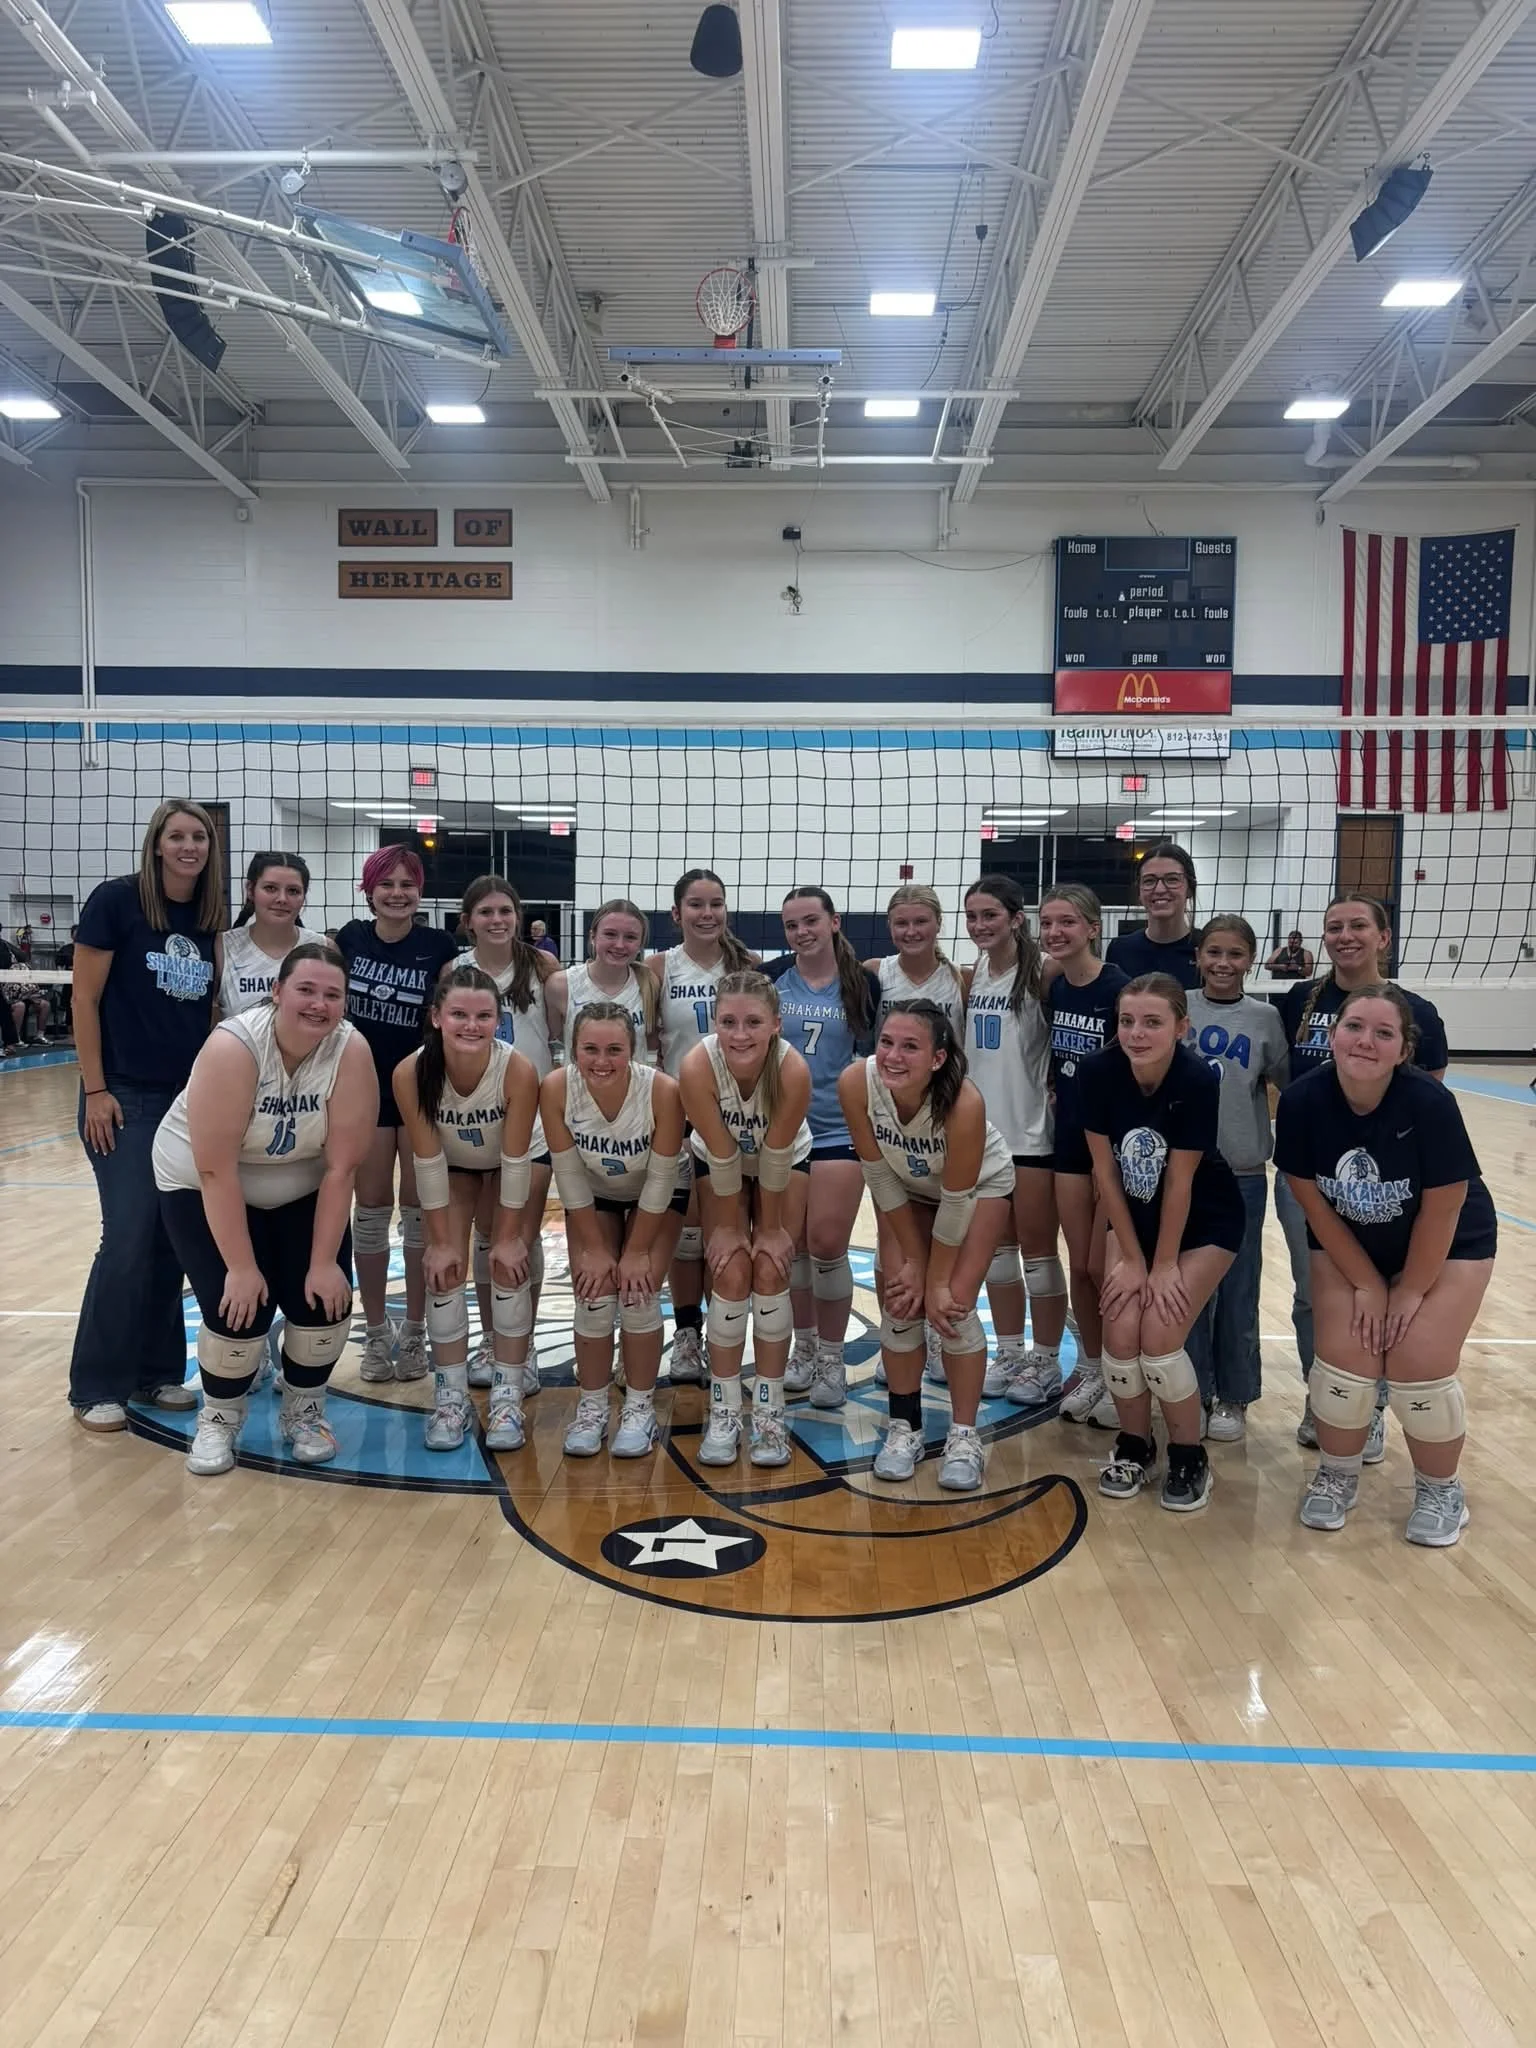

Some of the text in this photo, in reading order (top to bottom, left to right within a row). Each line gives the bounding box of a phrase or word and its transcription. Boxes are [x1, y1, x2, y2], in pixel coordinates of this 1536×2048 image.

[348, 519, 502, 536] WALL OF
[1068, 541, 1096, 554] Home
[1195, 542, 1232, 554] Guests
[349, 572, 502, 588] HERITAGE
[1130, 585, 1164, 599] period
[1064, 606, 1088, 619] fouls
[1128, 606, 1162, 620] player
[1204, 607, 1229, 619] fouls
[1065, 653, 1085, 663] won
[1132, 653, 1158, 665] game
[1205, 654, 1226, 663] won
[350, 956, 428, 991] SHAKAMAK
[240, 977, 274, 992] SHAK
[670, 985, 716, 999] SHAKA
[347, 994, 419, 1028] OLLEYBALL
[803, 1020, 824, 1055] 7
[974, 1014, 1001, 1049] 10
[1054, 1030, 1097, 1052] AKERS
[437, 1105, 505, 1126] HAKAMAK
[457, 1128, 485, 1147] 4
